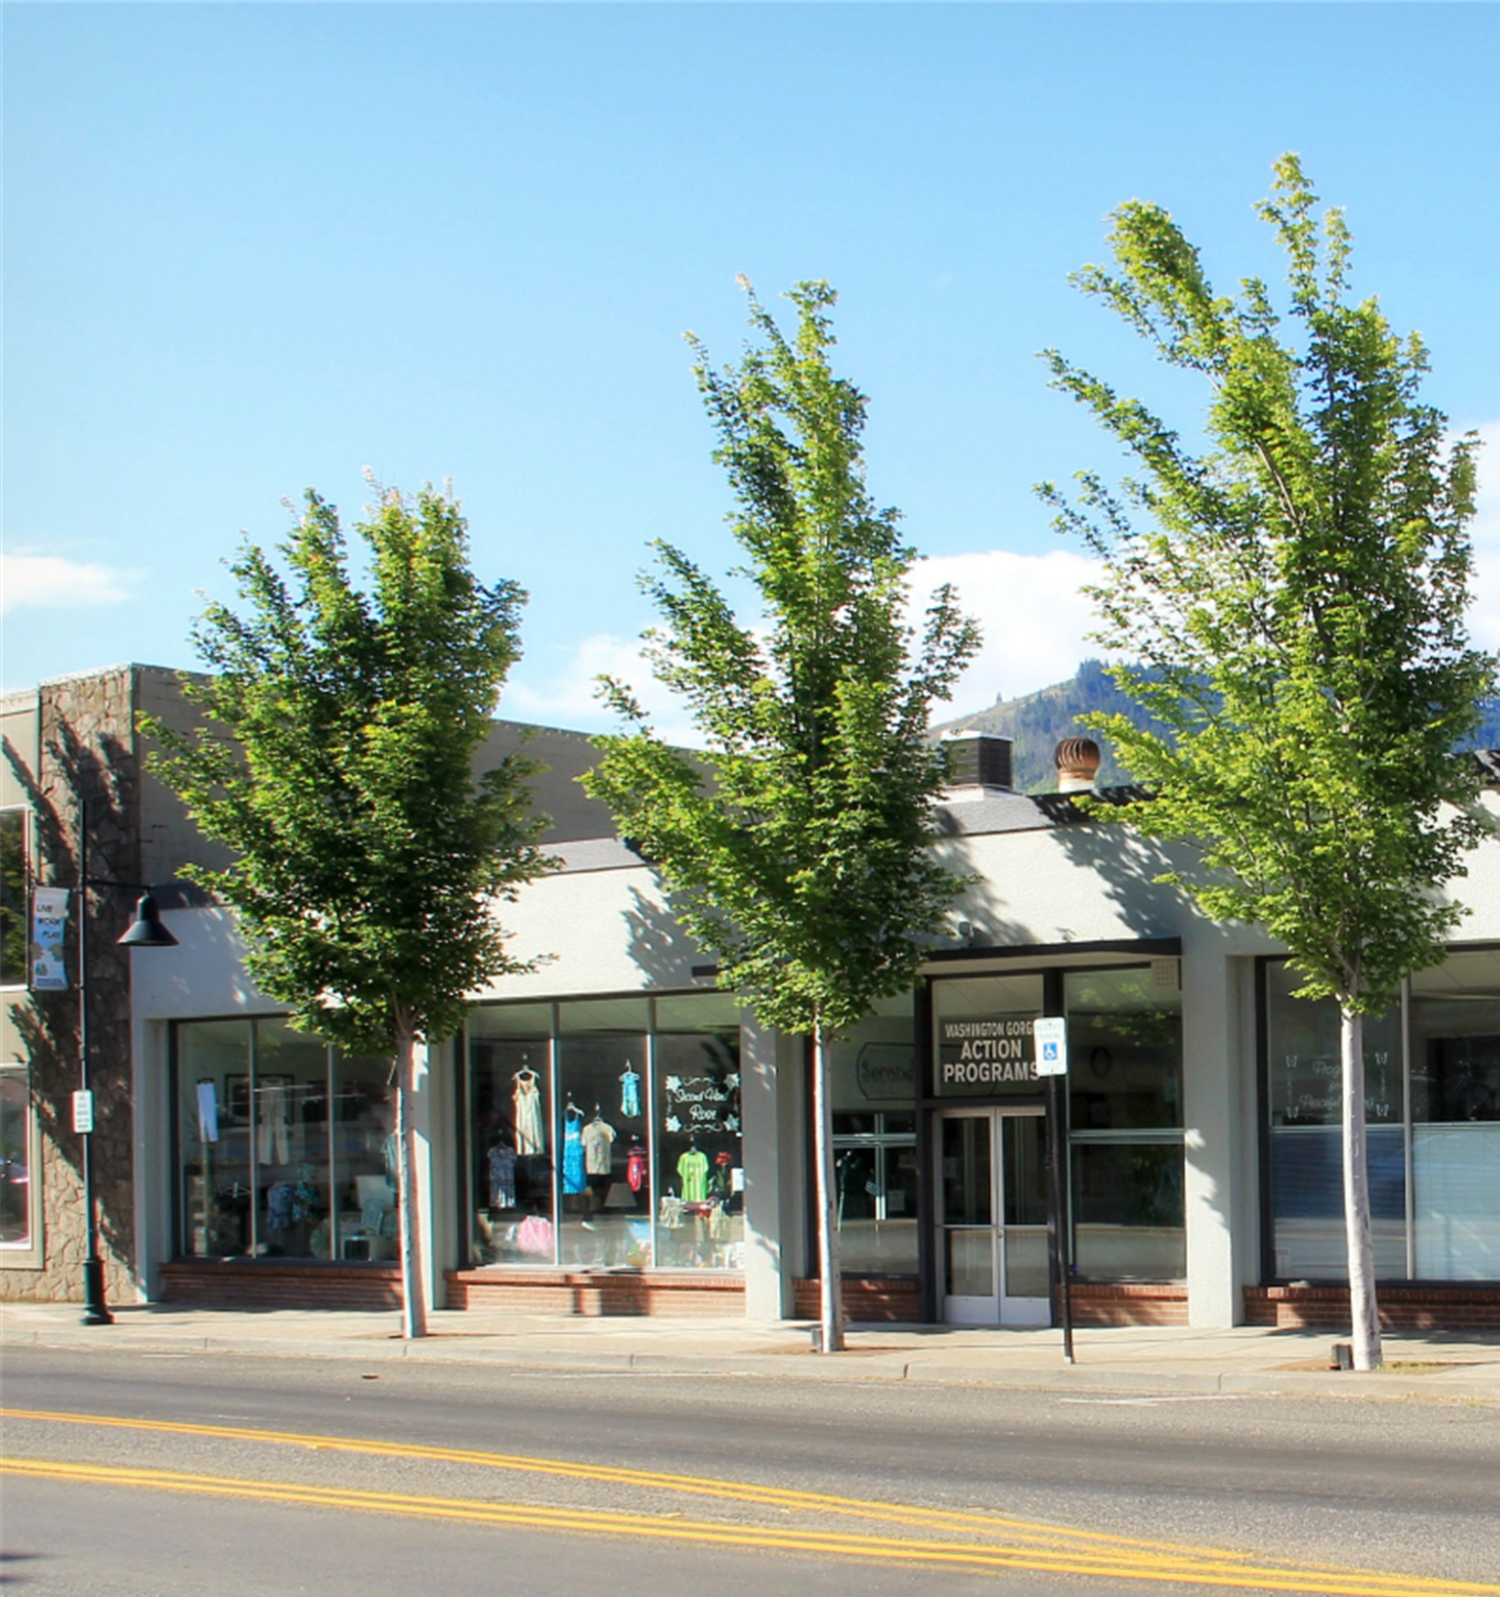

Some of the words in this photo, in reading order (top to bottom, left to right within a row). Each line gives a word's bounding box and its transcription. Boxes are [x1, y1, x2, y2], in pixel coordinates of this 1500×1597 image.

[945, 1022, 1005, 1038] WASHINGTON
[1006, 1020, 1034, 1036] GORG
[961, 1039, 1022, 1059] ACTION
[943, 1061, 1040, 1083] PROGRAMS
